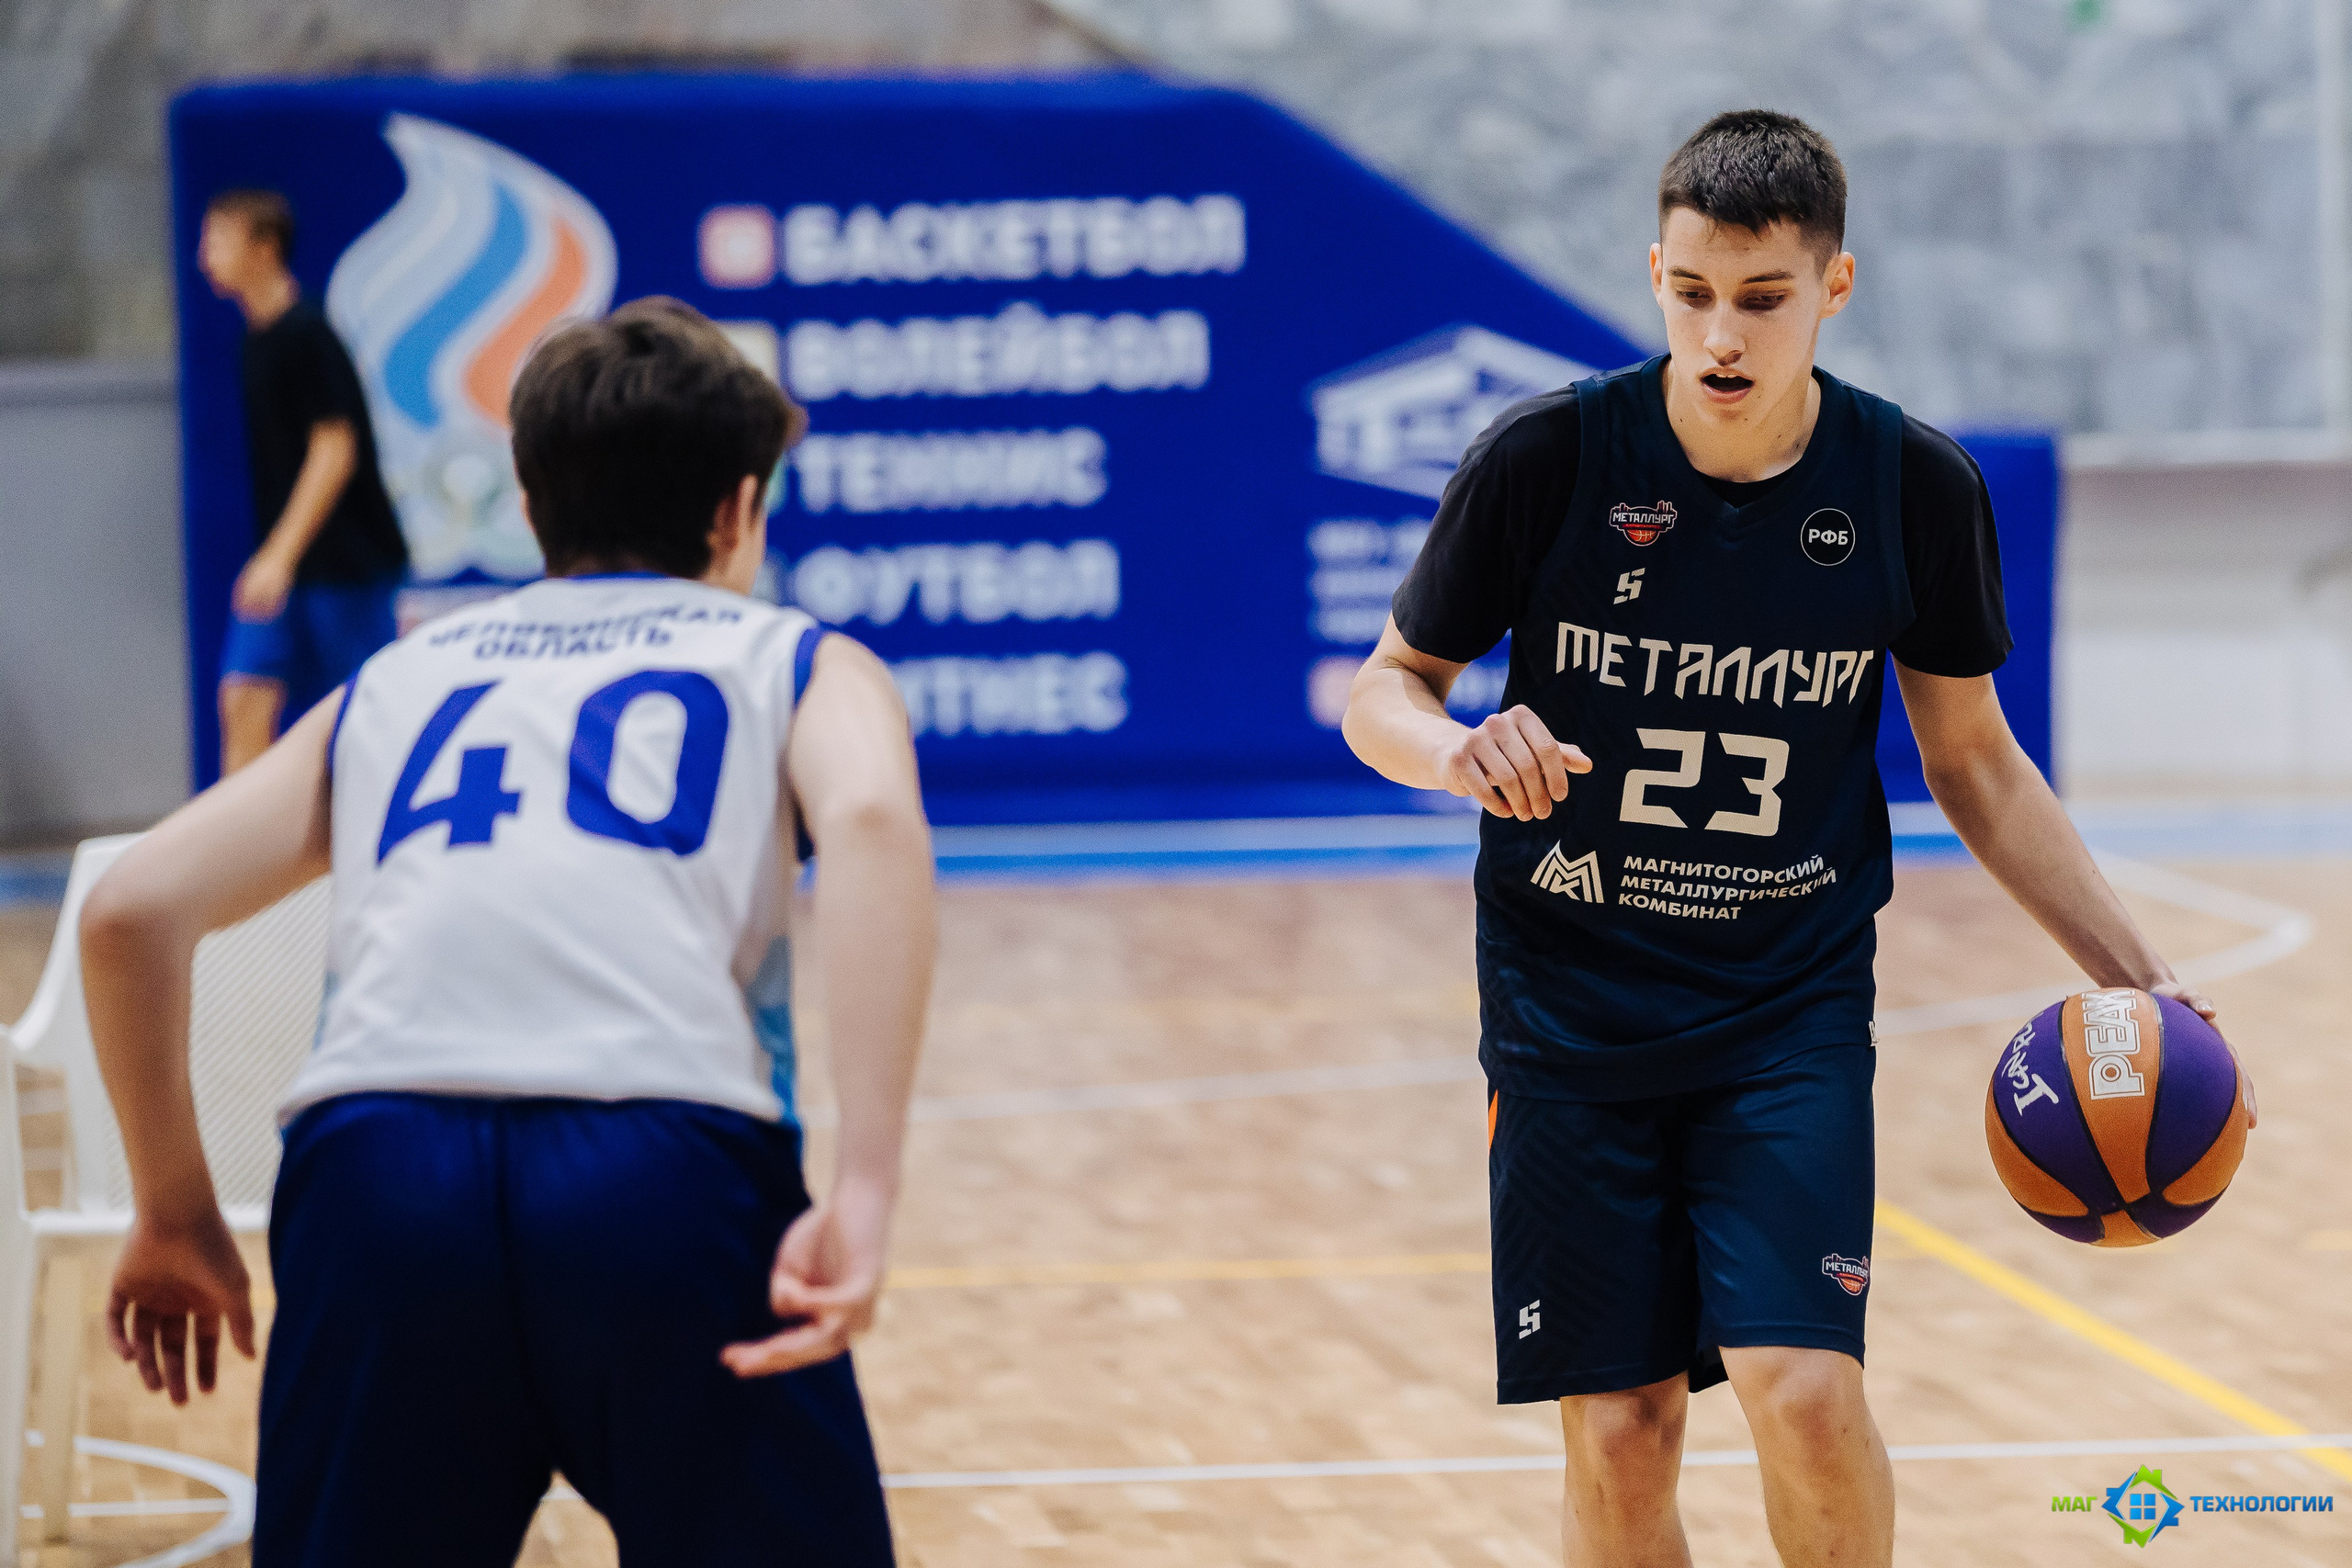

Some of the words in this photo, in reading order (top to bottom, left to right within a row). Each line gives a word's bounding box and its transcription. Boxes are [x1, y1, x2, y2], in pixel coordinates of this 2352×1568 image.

[786, 196, 1245, 284] БАСКЕТБОЛ
[1612, 512, 1674, 525] МЕТАЛЛУРГ
[1808, 528, 1849, 546] РФБ
[473, 625, 673, 660] ОБЛАСТЬ
[1555, 622, 1874, 708] МЕТАЛЛУРГ
[378, 670, 729, 867] 40
[1619, 728, 1791, 837] 23
[1621, 867, 1837, 901] МЕТАЛЛУРГИЧЕСКИЙ
[1623, 854, 1824, 884] МАГНИТОГОРСКИЙ
[1618, 893, 1741, 919] КОМБИНАТ
[2081, 990, 2145, 1100] PEAK
